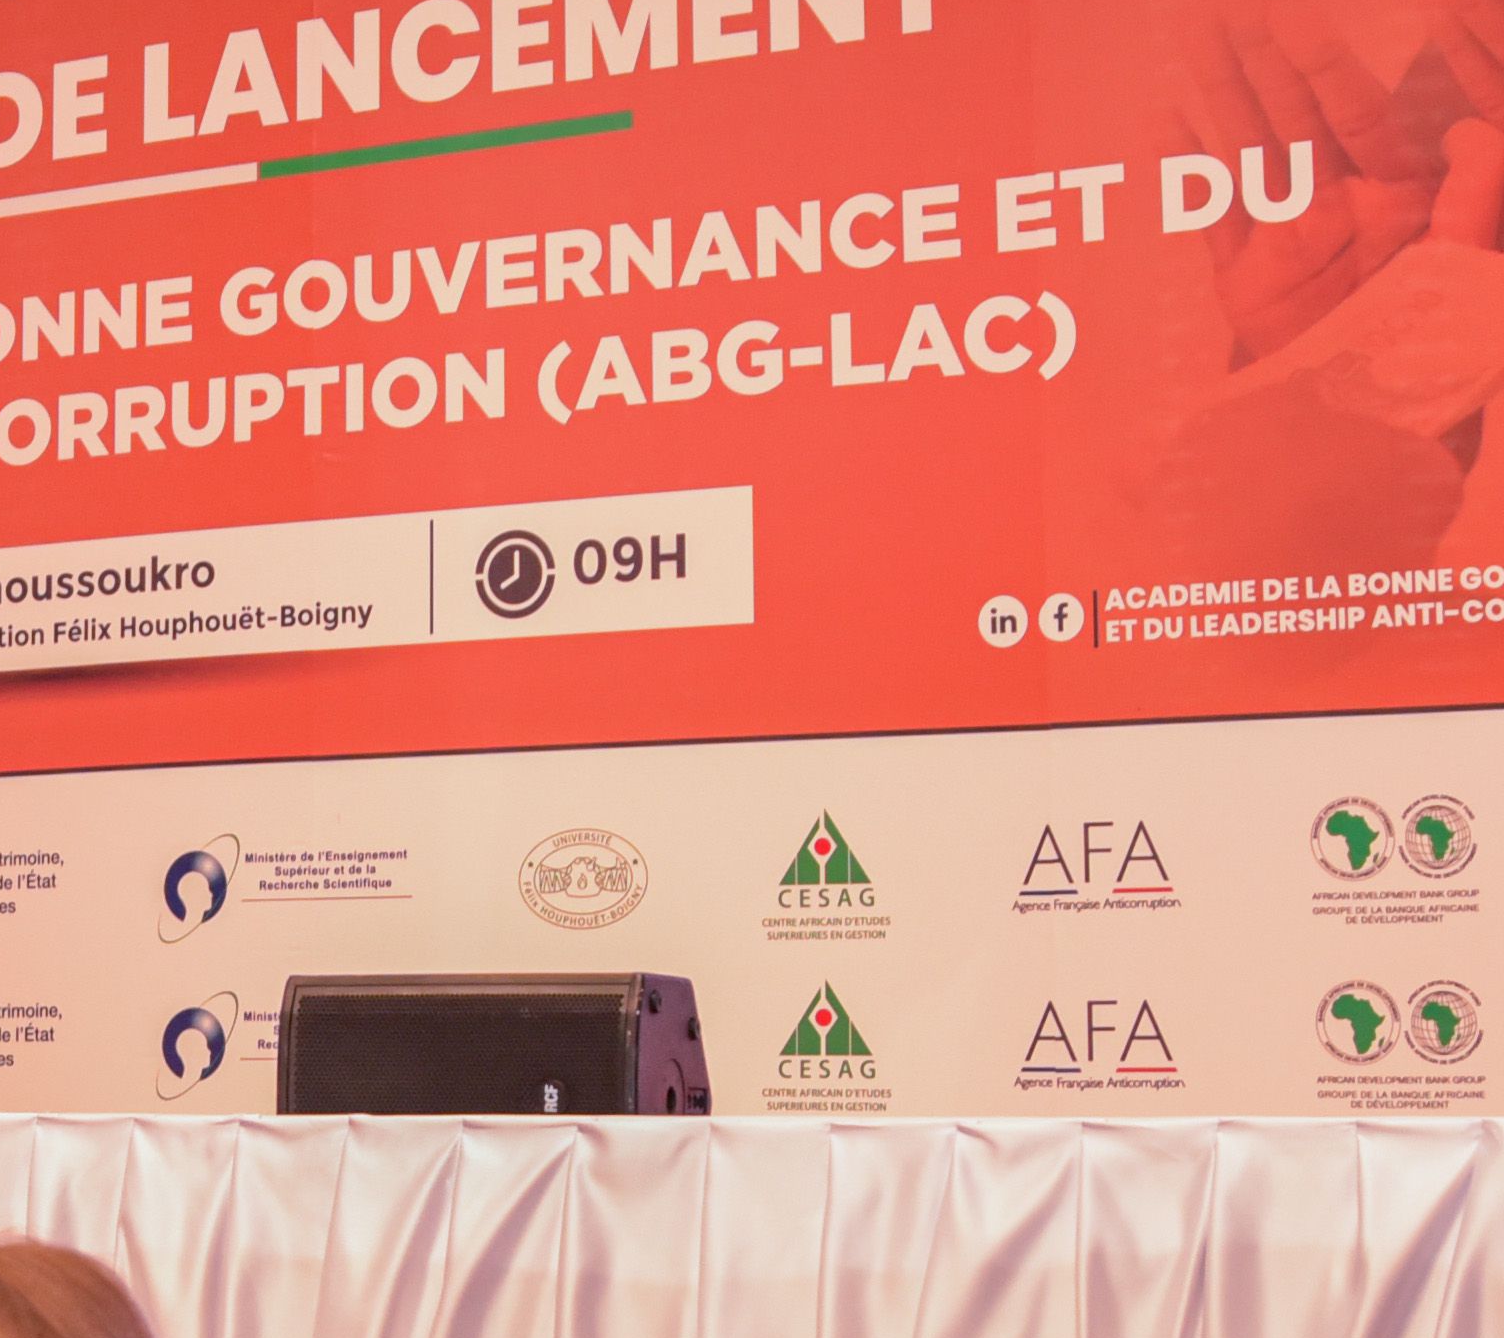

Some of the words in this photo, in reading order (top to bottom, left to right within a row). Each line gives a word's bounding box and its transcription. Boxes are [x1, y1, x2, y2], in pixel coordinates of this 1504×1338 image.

[220, 184, 961, 336] GOUVERNANCE
[996, 163, 1124, 252] ET
[1161, 141, 1313, 233] DU
[538, 291, 1076, 424] (ABG-LAC)
[574, 533, 685, 584] 09H
[1105, 580, 1256, 610] ACADEMIE
[1263, 577, 1299, 601] DE
[1306, 576, 1341, 599] LA
[1348, 568, 1453, 596] BONNE
[54, 618, 111, 643] Félix
[121, 602, 372, 640] Houphouët-Boigny
[991, 608, 1017, 634] in
[1054, 603, 1068, 632] f
[1106, 619, 1137, 642] ET
[1144, 616, 1183, 640] DU
[1190, 607, 1365, 637] LEADERSHIP
[552, 833, 613, 847] UNIVERSITÉ
[1023, 821, 1169, 885] AFA
[245, 853, 296, 863] Ministère
[301, 852, 314, 861] de
[275, 866, 330, 877] Supérieur
[334, 866, 344, 875] et
[349, 865, 362, 874] de
[367, 864, 376, 874] la
[260, 880, 319, 890] Recherche
[324, 878, 392, 890] Scientifique
[778, 888, 875, 908] CESAG
[1012, 900, 1051, 914] Agence
[1054, 899, 1100, 913] Française
[1103, 898, 1181, 910] Anticorruption
[762, 918, 797, 927] CENTRE
[799, 917, 842, 926] AFRICAIN
[767, 931, 828, 940] SUPERIEURES
[831, 931, 842, 939] EN
[845, 930, 886, 939] GESTION
[778, 1060, 877, 1079] CESAG
[544, 1084, 558, 1112] RCF
